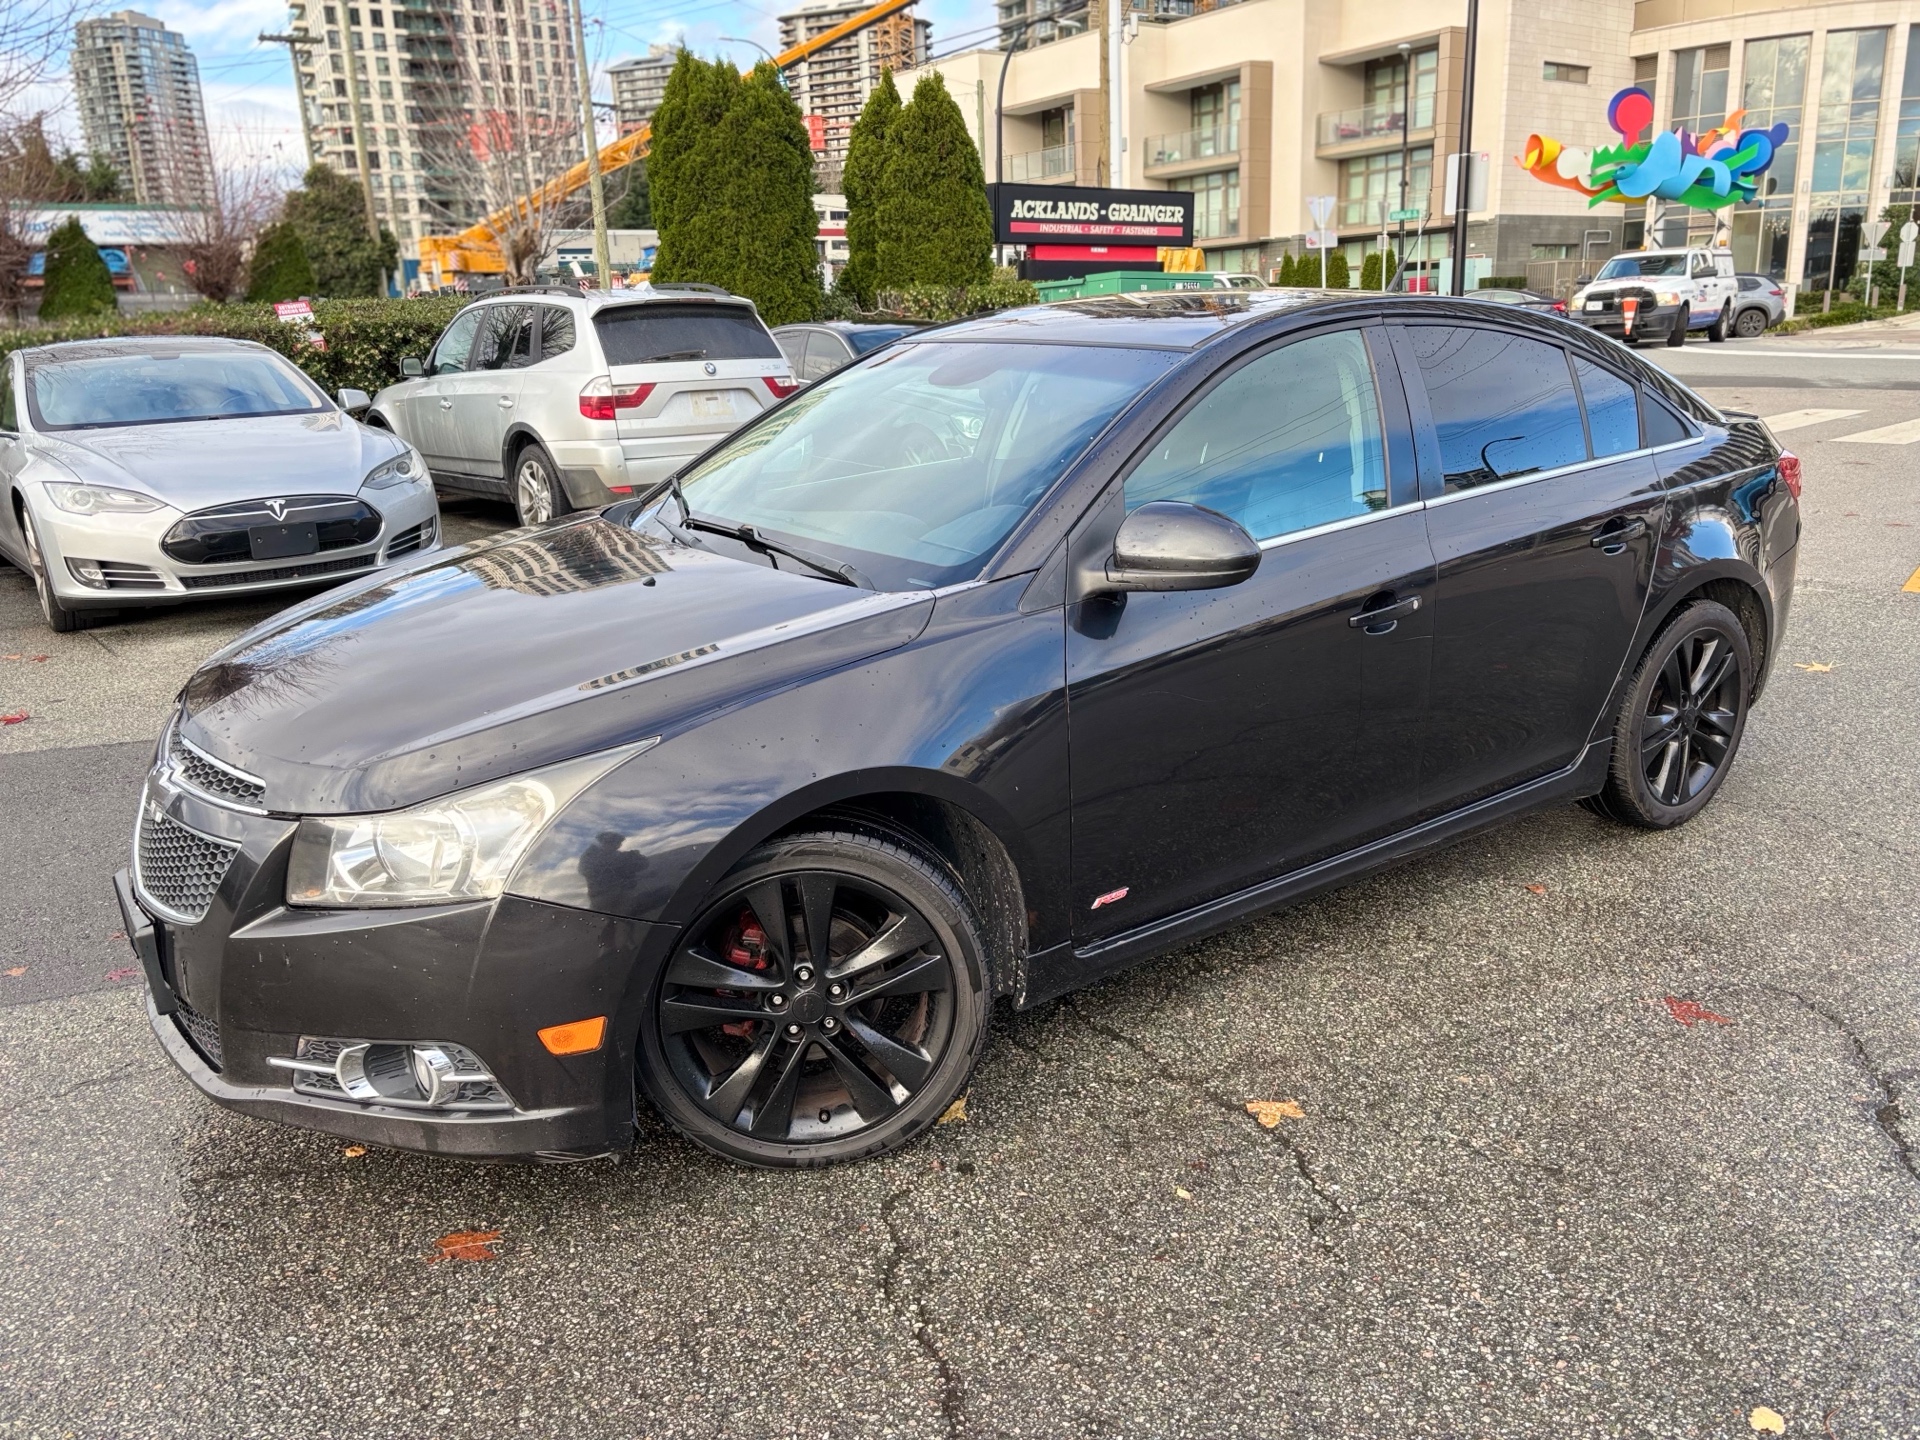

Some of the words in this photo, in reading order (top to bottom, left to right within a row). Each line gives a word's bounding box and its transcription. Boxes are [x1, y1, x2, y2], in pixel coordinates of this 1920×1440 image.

[1039, 223, 1083, 234] INDUSTRIAL
[1090, 225, 1116, 235] SAFETY
[1121, 227, 1158, 236] FASTENERS
